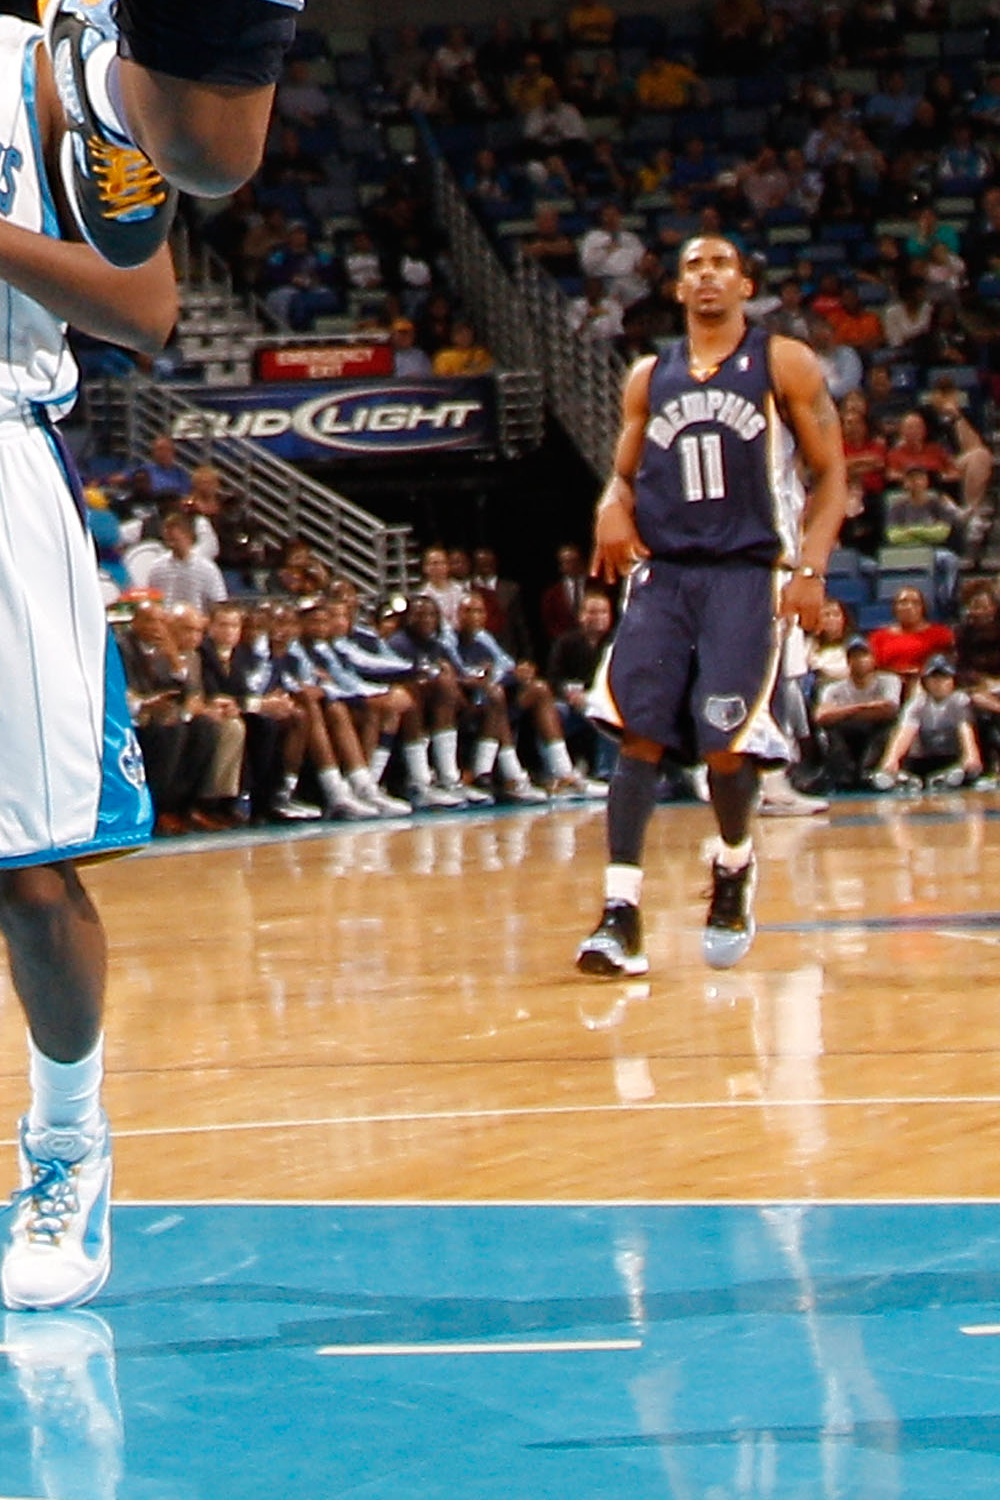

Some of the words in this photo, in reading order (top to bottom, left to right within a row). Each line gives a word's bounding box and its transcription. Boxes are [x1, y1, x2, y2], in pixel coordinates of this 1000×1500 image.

[321, 402, 483, 434] LIGHT
[647, 389, 767, 449] MEMPHIS
[681, 433, 726, 502] 11
